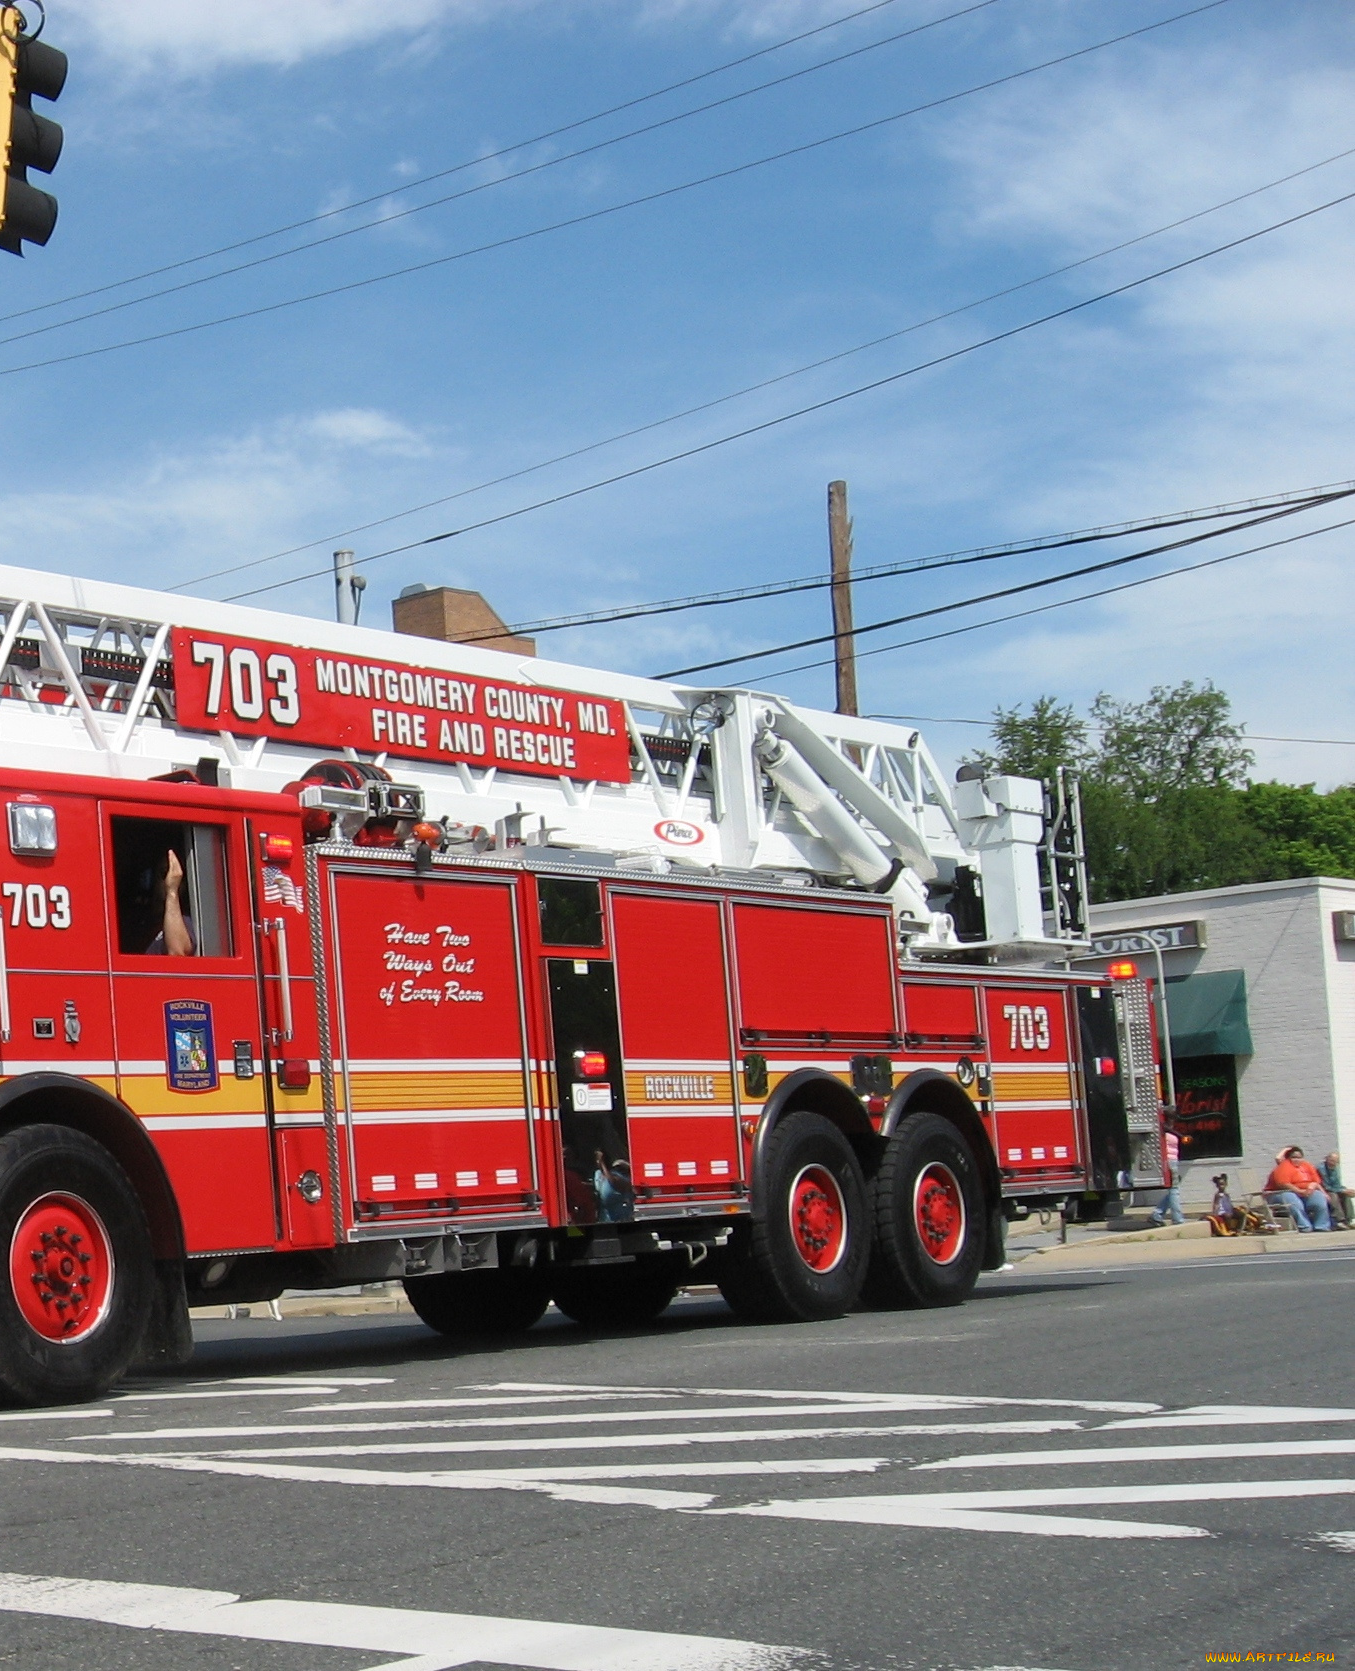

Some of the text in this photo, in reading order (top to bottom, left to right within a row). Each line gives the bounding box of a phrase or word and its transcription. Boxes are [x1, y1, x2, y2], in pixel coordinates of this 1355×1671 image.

[192, 640, 301, 726] 703
[315, 657, 616, 736] MONTGOMERY COUNTY, MD.
[371, 708, 576, 768] FIRE AND RESCUE
[666, 823, 693, 839] Pierce
[1, 882, 72, 930] 703
[383, 923, 470, 947] Have Two
[1086, 926, 1184, 956] ORIST
[383, 950, 475, 977] Ways Out
[379, 979, 484, 1006] of Every Room
[169, 1002, 204, 1011] ROCKVILLE
[170, 1013, 206, 1021] VOLUNTEER
[1003, 1005, 1050, 1050] 703
[645, 1075, 714, 1100] ROCKVILLE
